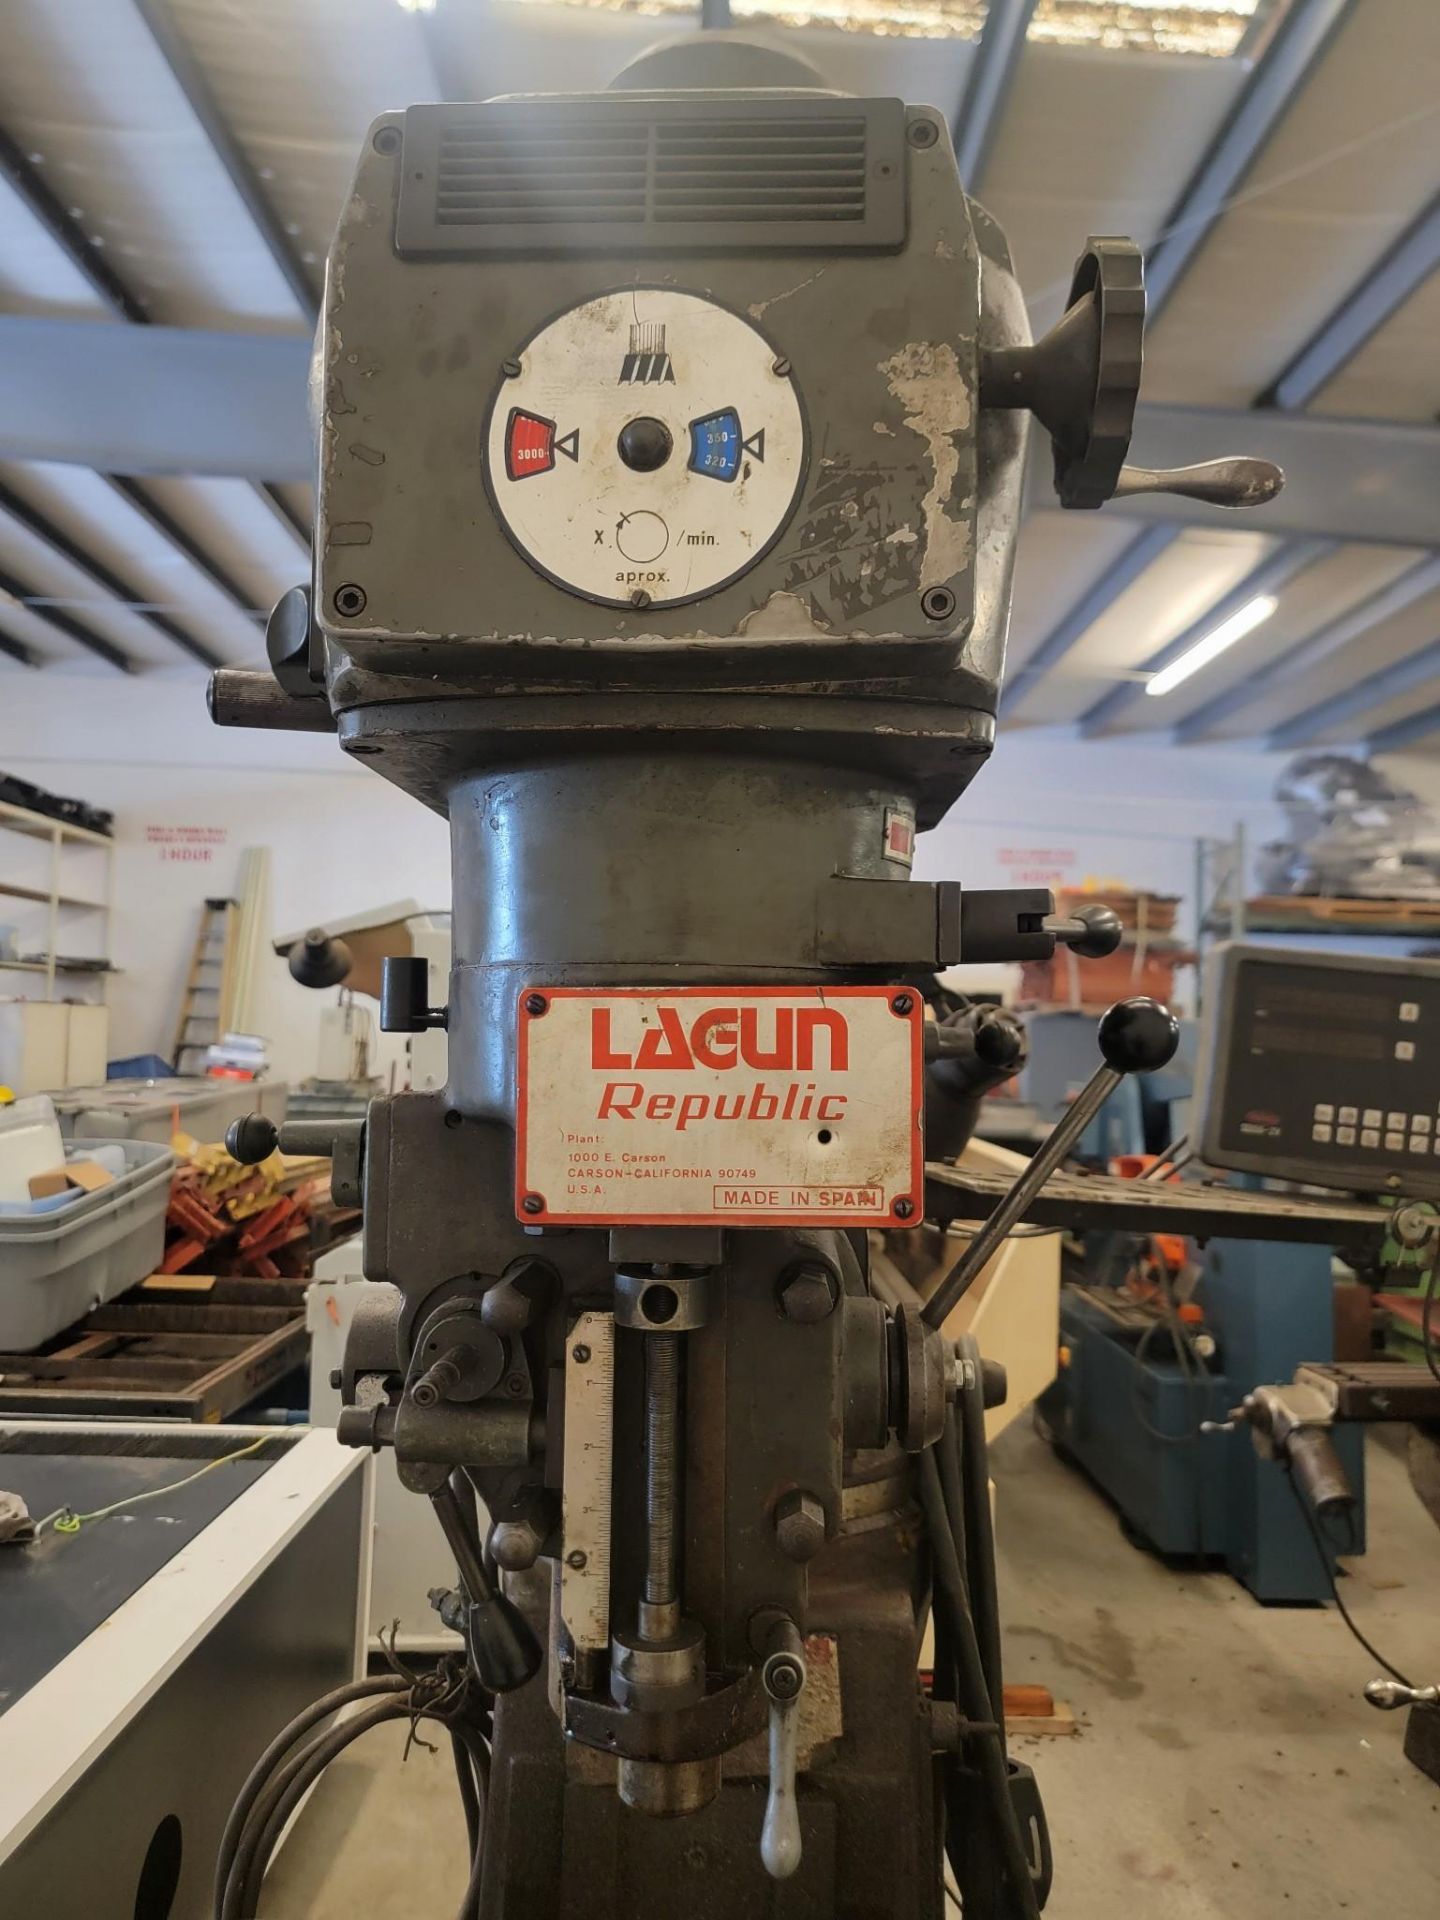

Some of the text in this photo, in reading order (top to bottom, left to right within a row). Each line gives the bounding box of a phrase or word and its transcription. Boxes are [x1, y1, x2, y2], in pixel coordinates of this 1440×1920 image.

[518, 448, 544, 460] 3000
[594, 529, 604, 545] X
[615, 571, 670, 585] aprox.
[591, 1007, 849, 1071] LAGUN
[597, 1082, 848, 1131] Republic
[567, 1134, 604, 1144] Plant:
[568, 1153, 599, 1162] 1000
[621, 1152, 666, 1163] Carson
[718, 1168, 757, 1178] 90749
[567, 1184, 606, 1194] U.S.A.
[724, 1190, 877, 1207] MADE IN SPAIN
